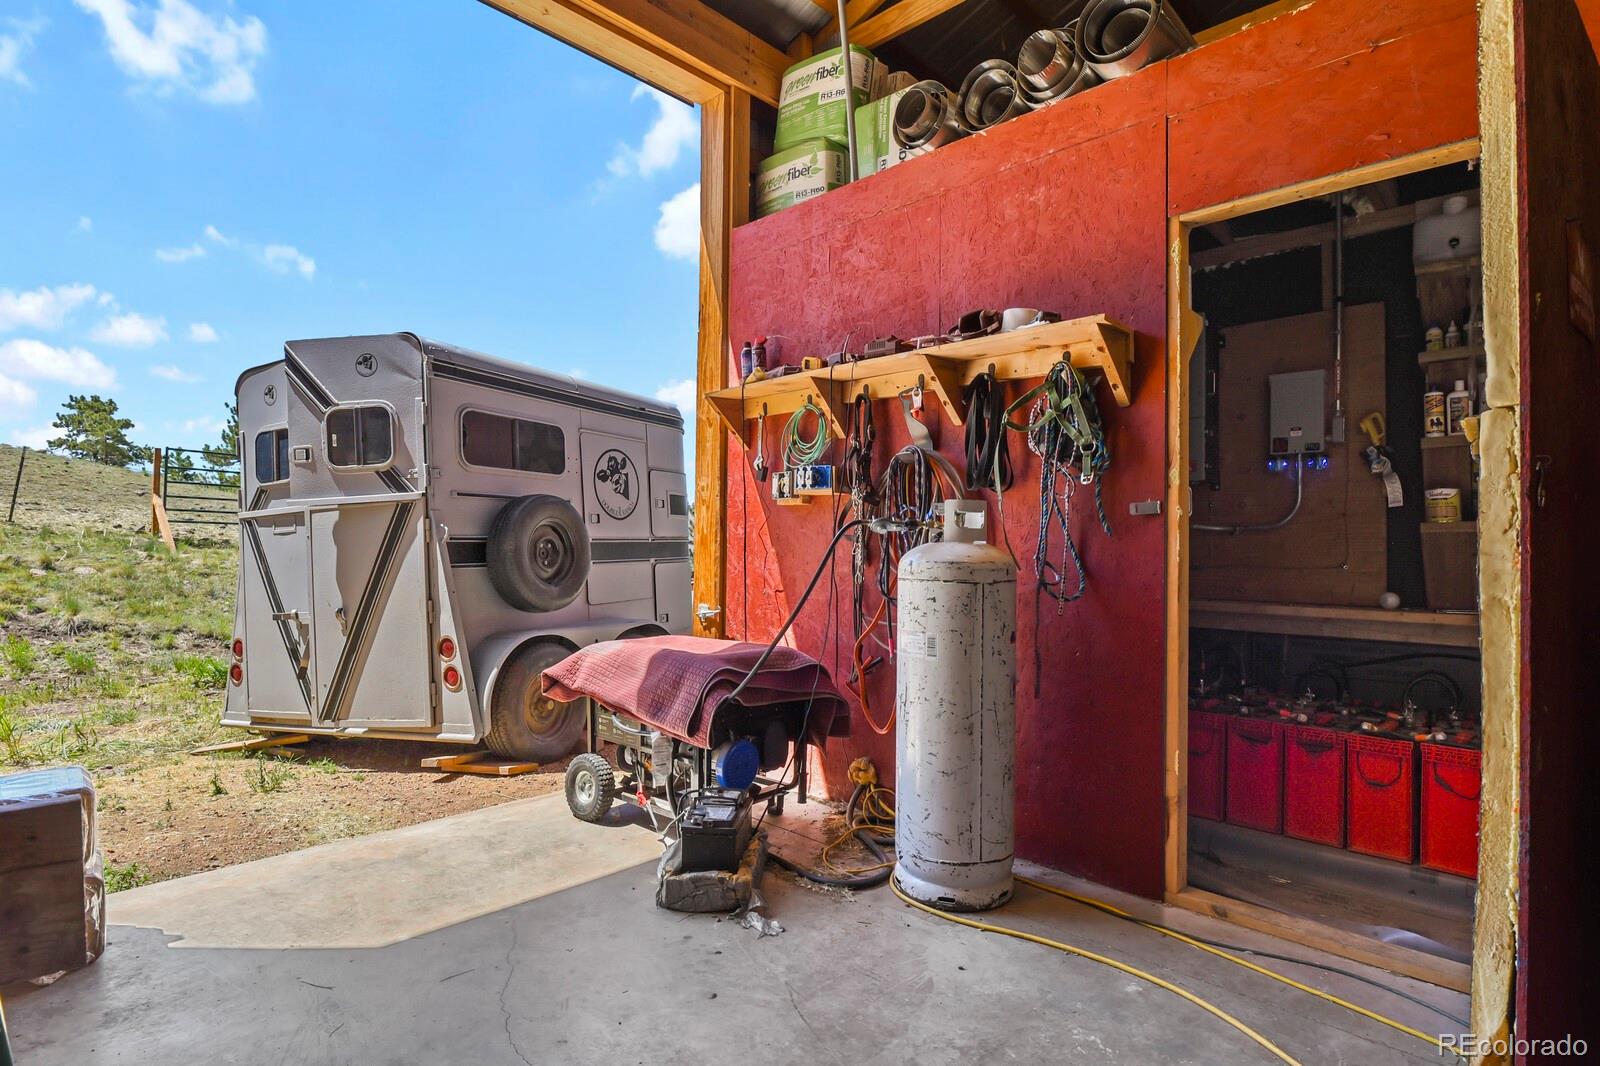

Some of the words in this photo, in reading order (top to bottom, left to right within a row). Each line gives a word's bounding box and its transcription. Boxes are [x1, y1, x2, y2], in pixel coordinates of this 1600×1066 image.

[784, 64, 841, 101] greenfiber
[820, 88, 846, 101] R13-R6
[795, 186, 825, 199] R13-R60
